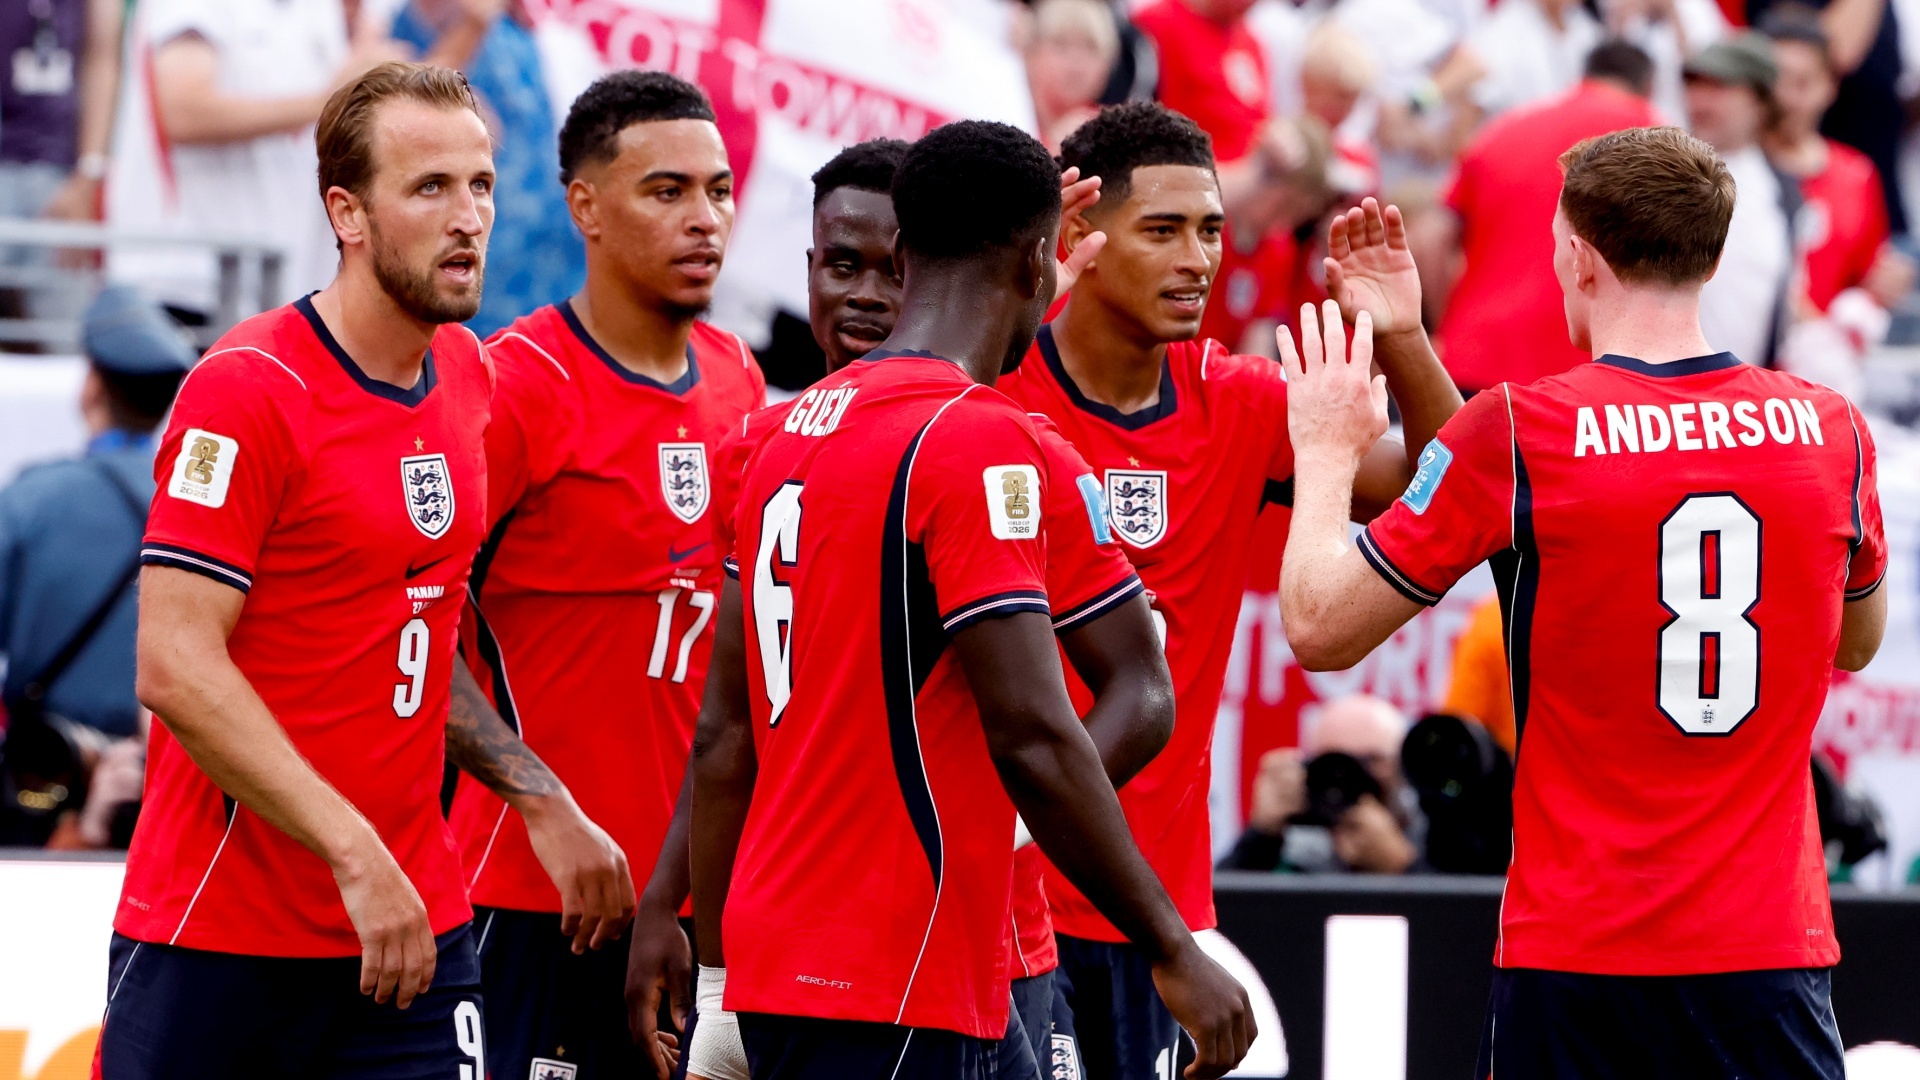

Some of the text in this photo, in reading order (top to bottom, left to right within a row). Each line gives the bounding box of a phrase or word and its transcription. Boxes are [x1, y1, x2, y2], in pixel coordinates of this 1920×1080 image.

[1574, 398, 1824, 457] ANDERSON
[180, 486, 208, 499] 2026
[190, 472, 205, 481] FIFA
[646, 588, 715, 684] 17
[753, 479, 804, 729] 6
[1655, 491, 1763, 737] 8
[392, 617, 430, 719] 9
[795, 975, 853, 989] AERO-FIT
[454, 1001, 485, 1080] 9
